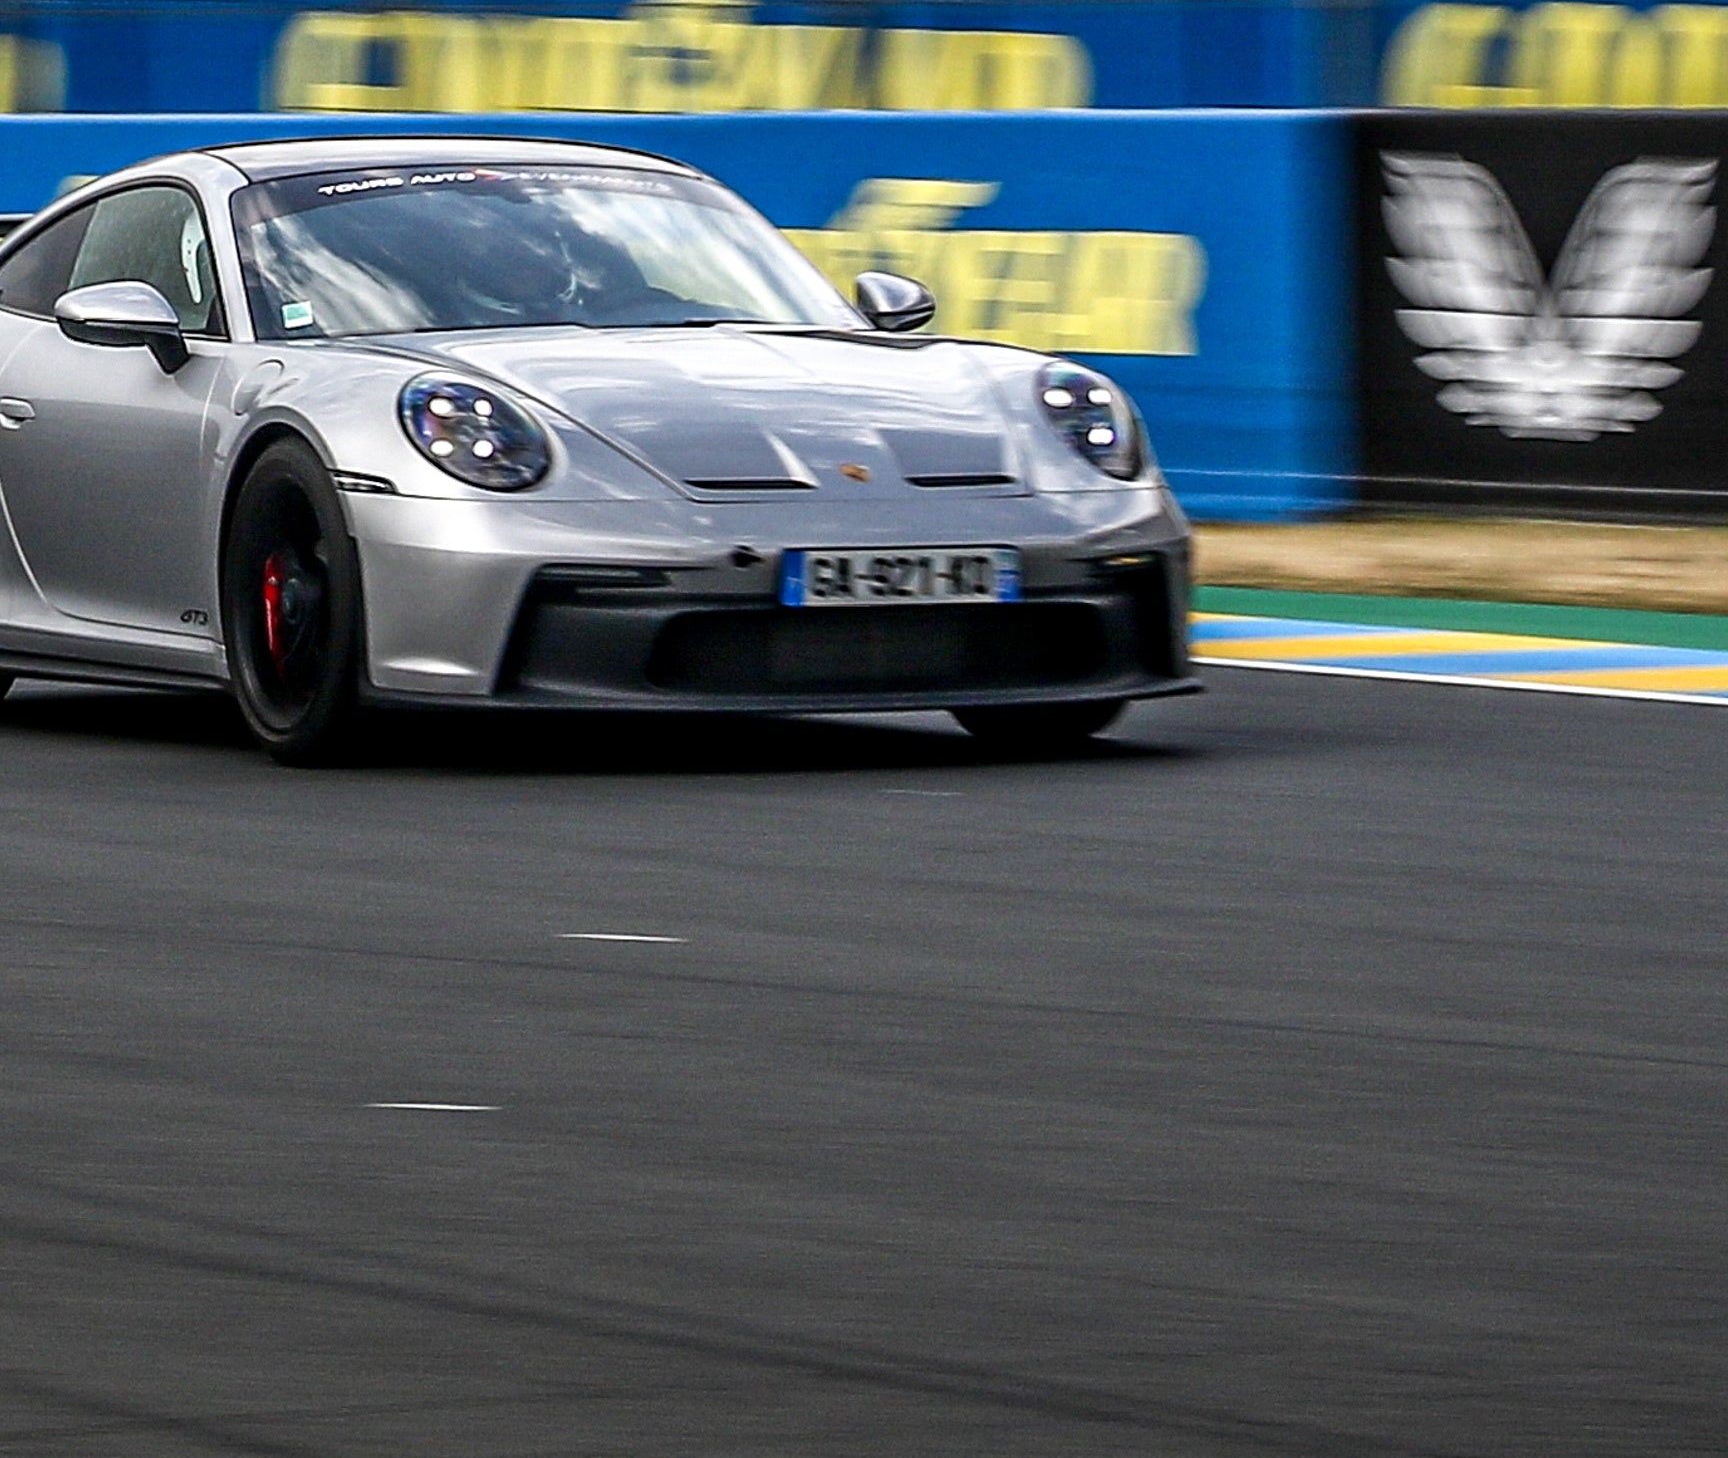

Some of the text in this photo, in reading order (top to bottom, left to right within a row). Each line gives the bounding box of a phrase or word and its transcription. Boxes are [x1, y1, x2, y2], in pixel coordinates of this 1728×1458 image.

[317, 176, 404, 195] TOURS
[410, 171, 476, 186] AUTO
[179, 608, 209, 627] GT3
